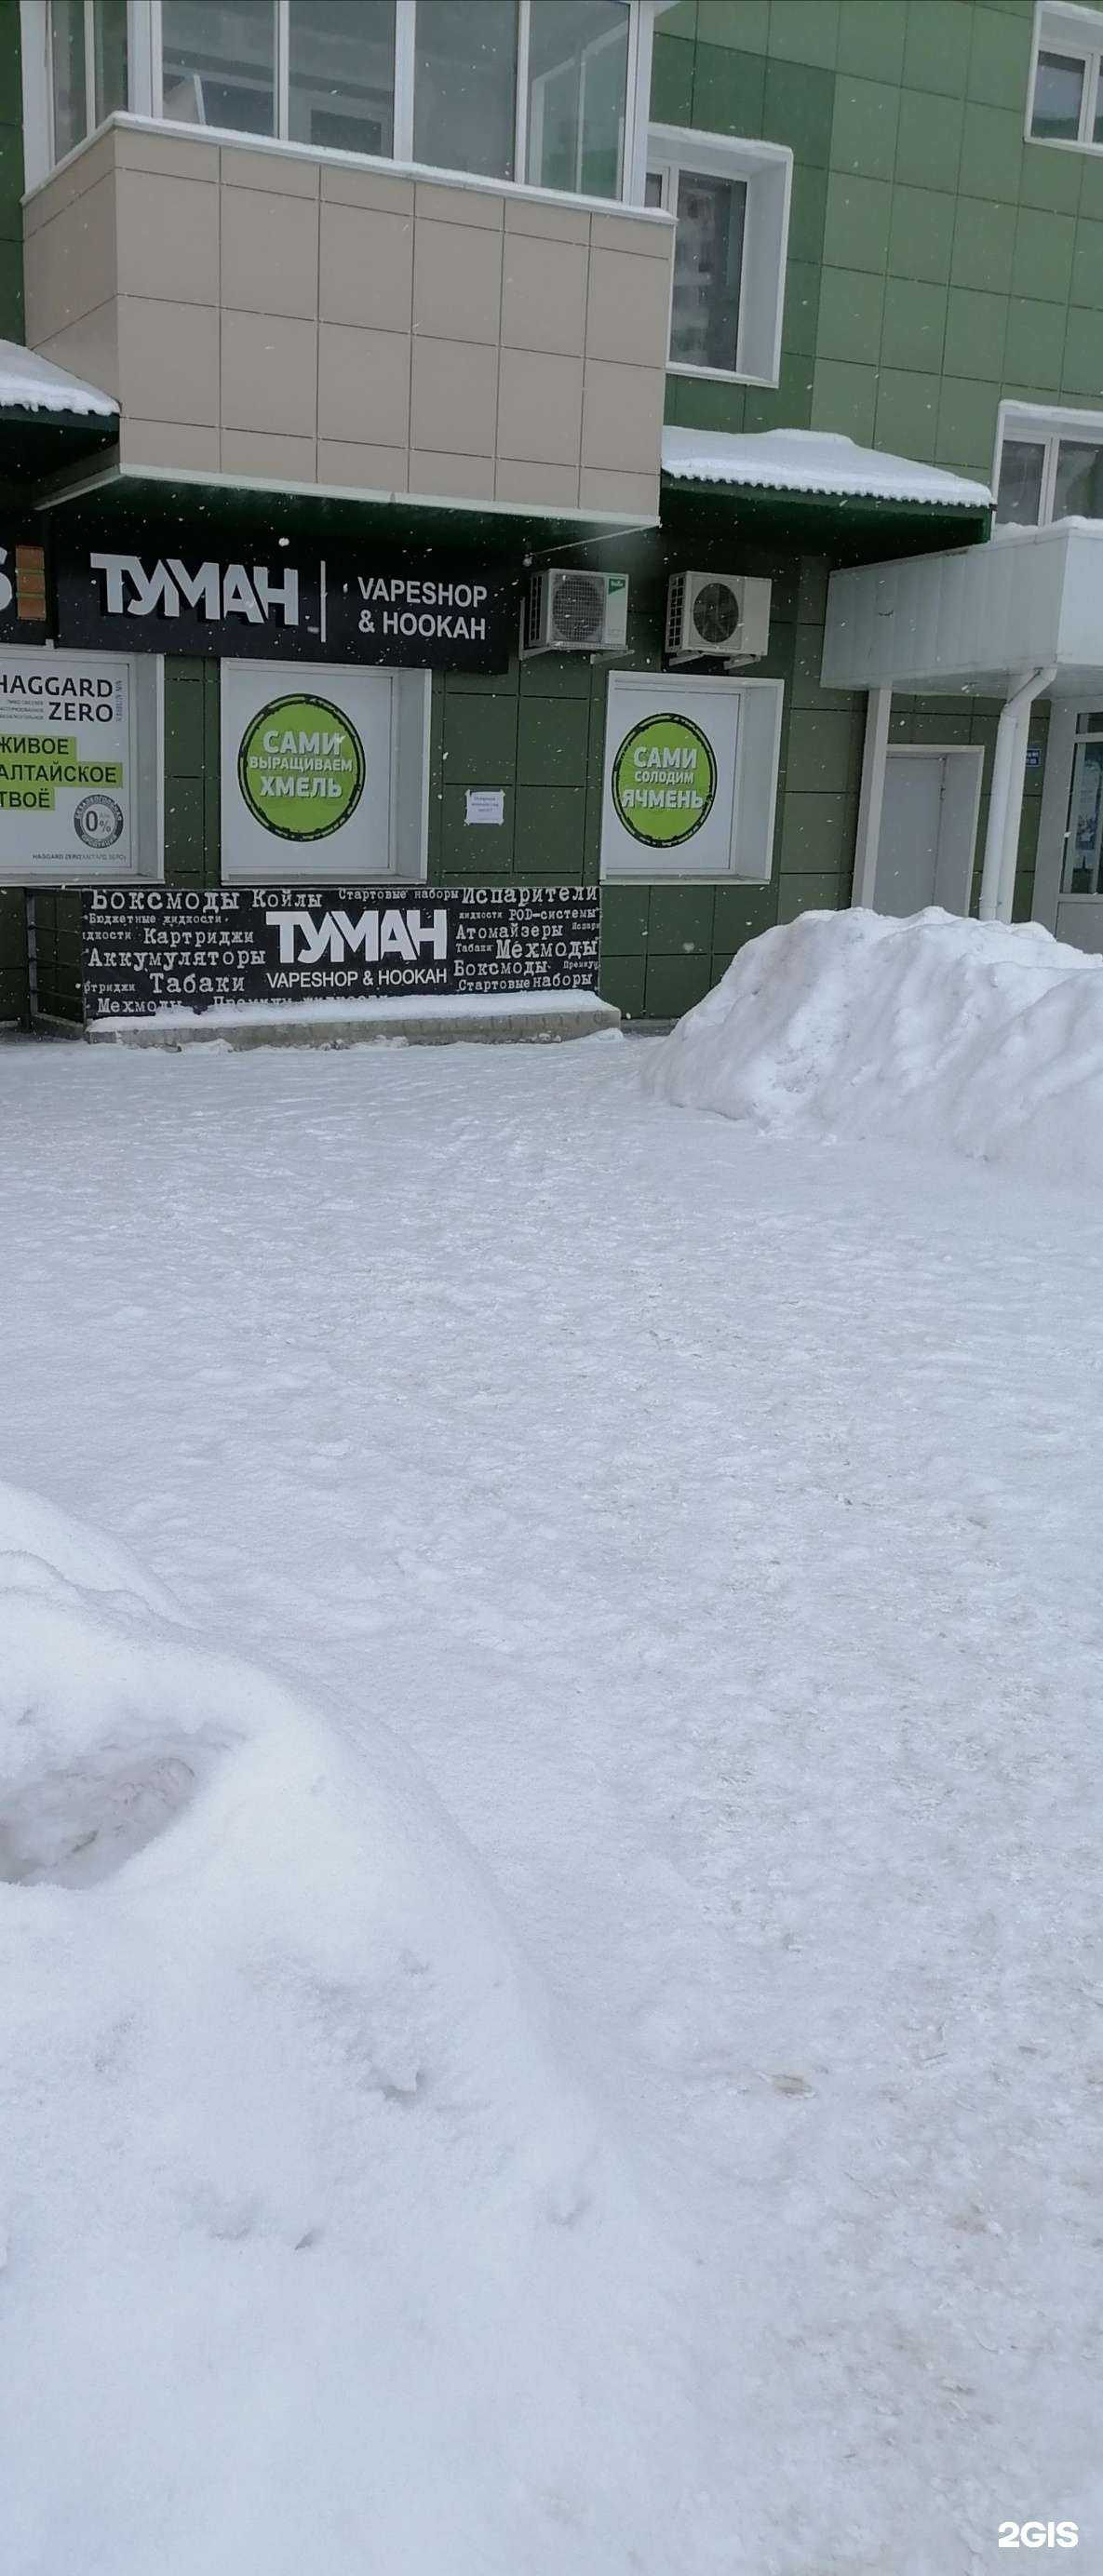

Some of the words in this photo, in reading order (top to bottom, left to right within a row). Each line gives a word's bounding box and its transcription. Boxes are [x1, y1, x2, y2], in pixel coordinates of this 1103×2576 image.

[90, 553, 299, 625] ТУМАН
[357, 577, 487, 608] VAPESHOP
[358, 610, 374, 633] &
[383, 610, 486, 640] HOOKAH
[48, 702, 114, 723] ZERO
[263, 731, 342, 755] САМИ
[249, 756, 353, 772] ВЫРАЩИВАЕМ
[634, 746, 697, 769] САМИ
[0, 759, 117, 783] АЛТАЙСКОЕ
[635, 771, 693, 785] СОЛОДИМ
[261, 776, 343, 798] ХМЕЛЬ
[0, 788, 50, 808] ТВОЁ
[623, 789, 706, 809] ЯЧМЕНЬ
[91, 890, 240, 913] Боксмоды
[252, 889, 322, 908] Койлы
[339, 888, 407, 902] Стартовые
[462, 886, 598, 906] Испарители
[89, 913, 156, 926] Бюджетные
[143, 928, 254, 947] Картриджи
[266, 909, 447, 963] ТУМАН
[456, 922, 563, 941] Атомайзеры
[496, 939, 598, 959] Мехмоды
[88, 947, 266, 972] Аккумуляторы
[453, 959, 547, 976] Боксмоды
[149, 973, 246, 994] Табаки
[267, 971, 358, 987] VAPESHOP
[362, 970, 373, 986] &
[379, 969, 447, 985] HOOKAH
[459, 979, 530, 992] Стартовые
[533, 973, 593, 988] наборы
